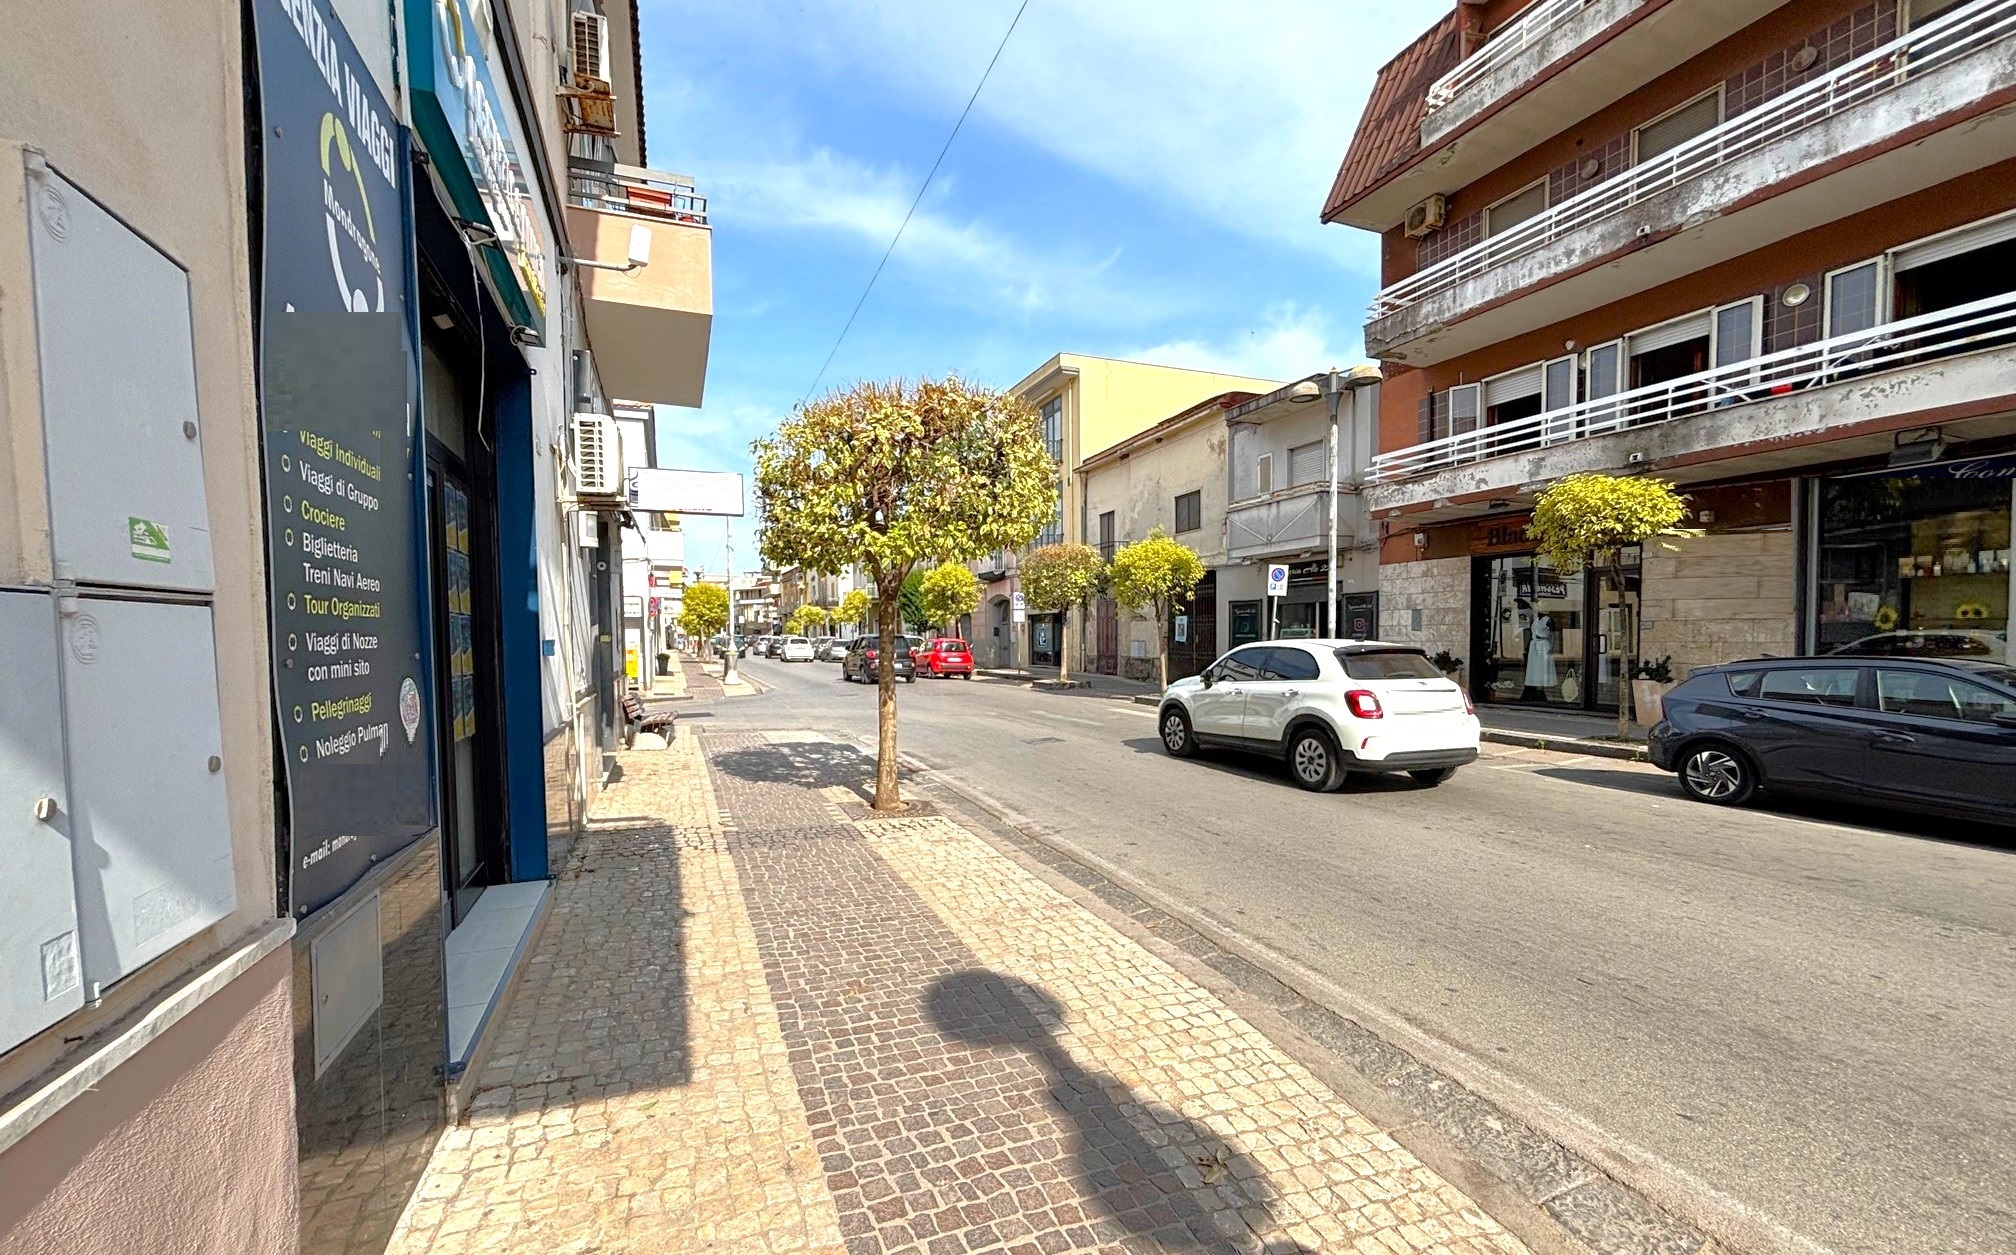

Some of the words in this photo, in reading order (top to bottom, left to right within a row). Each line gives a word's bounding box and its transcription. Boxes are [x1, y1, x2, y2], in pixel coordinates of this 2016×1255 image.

[344, 62, 396, 190] VIAGGI
[335, 443, 381, 482] Individuali
[299, 460, 334, 495] Viaggi
[336, 480, 346, 498] di
[347, 483, 379, 512] Gruppo
[301, 500, 346, 531] Crociere
[302, 532, 359, 563] Biglietteria
[303, 562, 331, 586] Treni
[333, 568, 355, 589] Navi
[356, 572, 381, 592] Aereo
[304, 594, 330, 615] Tour
[331, 597, 381, 619] Organizzati
[305, 631, 340, 655] Viaggi
[342, 632, 351, 650] di
[353, 632, 378, 650] Nozze
[308, 665, 328, 682] con
[331, 660, 352, 680] mini
[354, 659, 370, 677] sito
[311, 692, 373, 722] Pellegrinaggi
[316, 730, 357, 759] Noleggio
[302, 839, 331, 869] e-mail:
